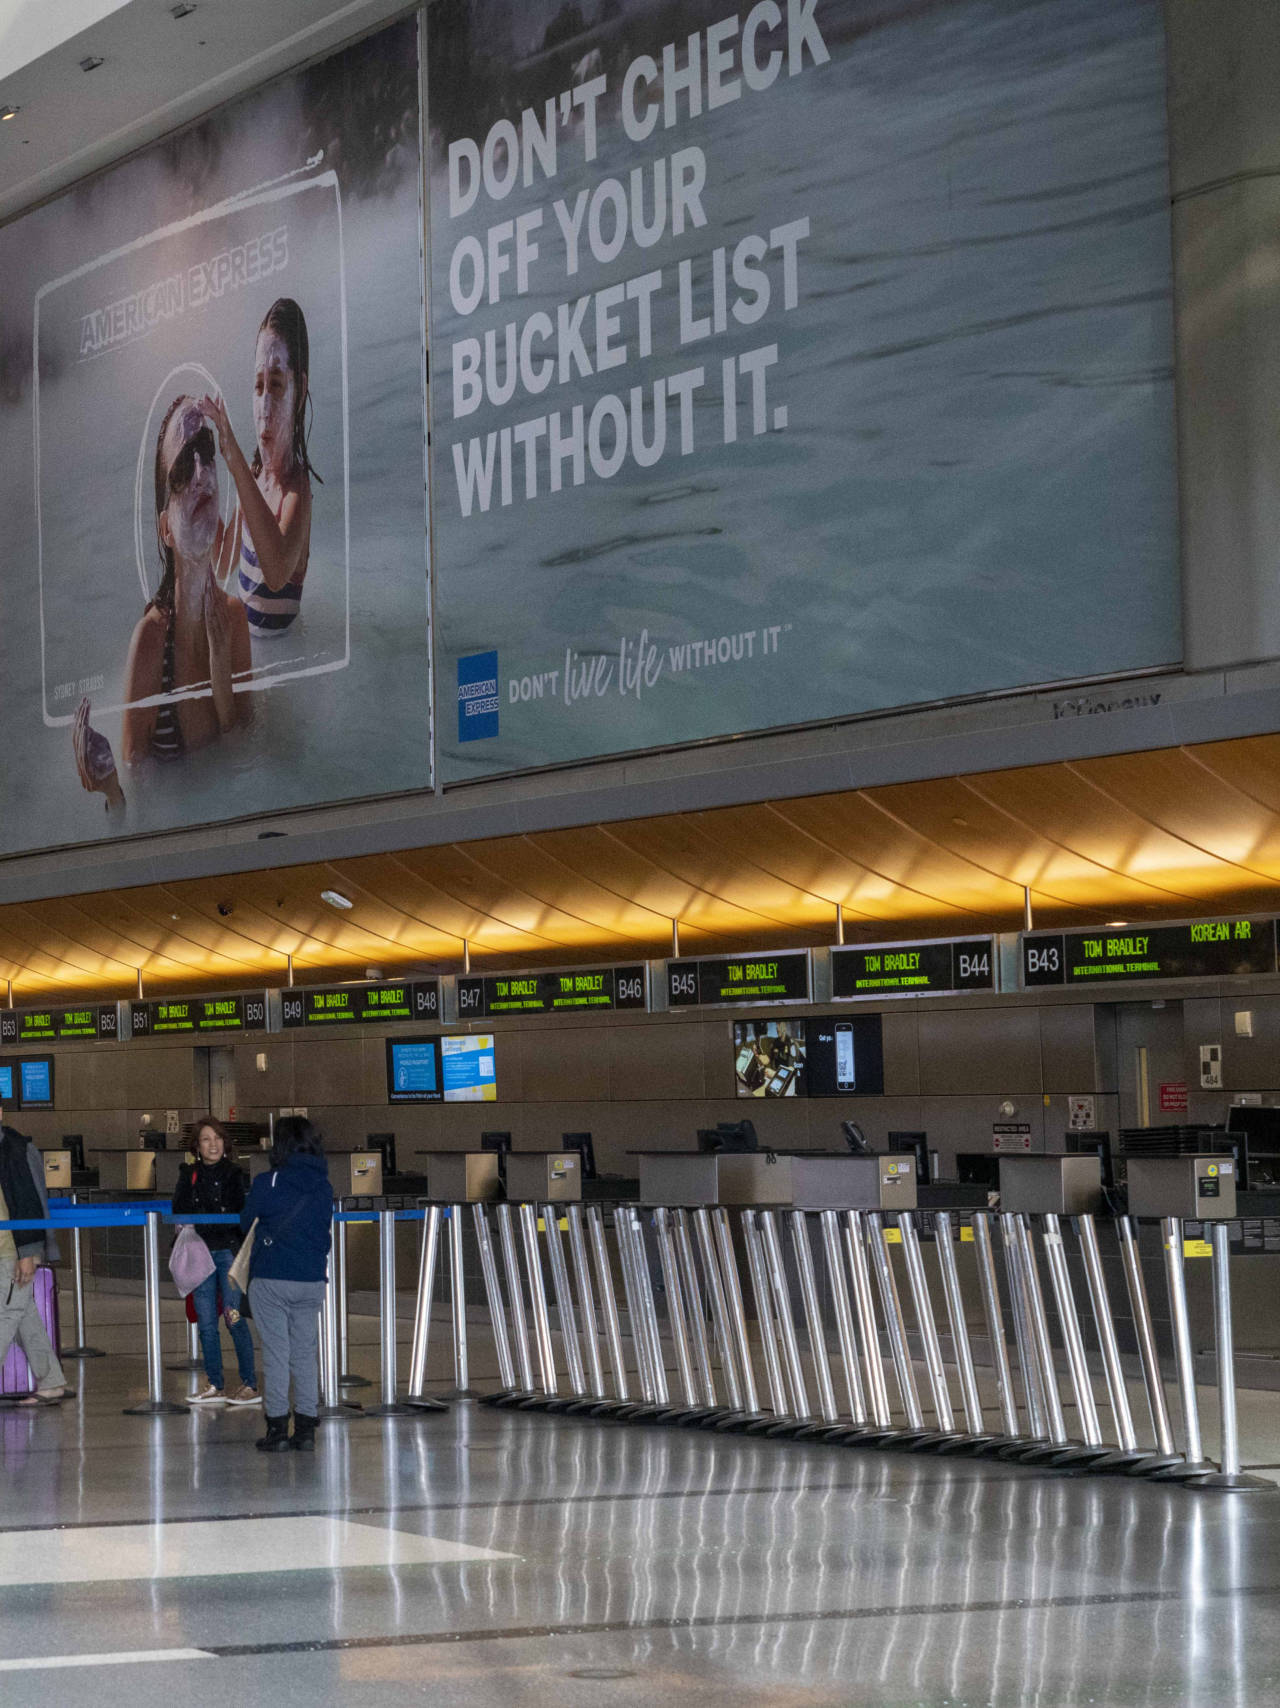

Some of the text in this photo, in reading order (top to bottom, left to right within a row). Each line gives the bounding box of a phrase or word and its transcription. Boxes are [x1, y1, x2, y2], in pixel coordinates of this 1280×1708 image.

[449, 0, 831, 218] DON'T CHECK
[449, 146, 708, 316] OFF YOUR
[79, 225, 289, 354] AMERICAN EXPRESS
[452, 216, 810, 420] BUCKET LIST
[452, 343, 788, 518] WITHOUT IT.
[509, 626, 781, 706] DON'T live life WITHOUT IT
[458, 679, 496, 699] AMERICAN
[465, 697, 499, 716] EXPRESS
[1190, 920, 1251, 943] KOREAN AIR
[1083, 936, 1149, 958] TOM BRADLEY
[864, 953, 920, 972] TOM BRADLEY
[960, 954, 989, 977] B44
[1028, 948, 1059, 972] B43
[727, 963, 778, 981] TOM BRADLEY
[496, 980, 537, 996] TOM BRADLEY
[560, 975, 603, 992] TOM BRADLEY
[619, 978, 641, 999] B46
[671, 974, 696, 996] B45
[314, 993, 349, 1008] TOM BRADLEY
[368, 989, 404, 1005] TOM BRADLEY
[417, 992, 436, 1010] B48
[460, 989, 480, 1008] B47
[247, 1003, 263, 1020] B50
[284, 1001, 301, 1019] B49
[2, 1020, 16, 1036] B53
[101, 1013, 116, 1031] B52
[133, 1012, 148, 1029] B51
